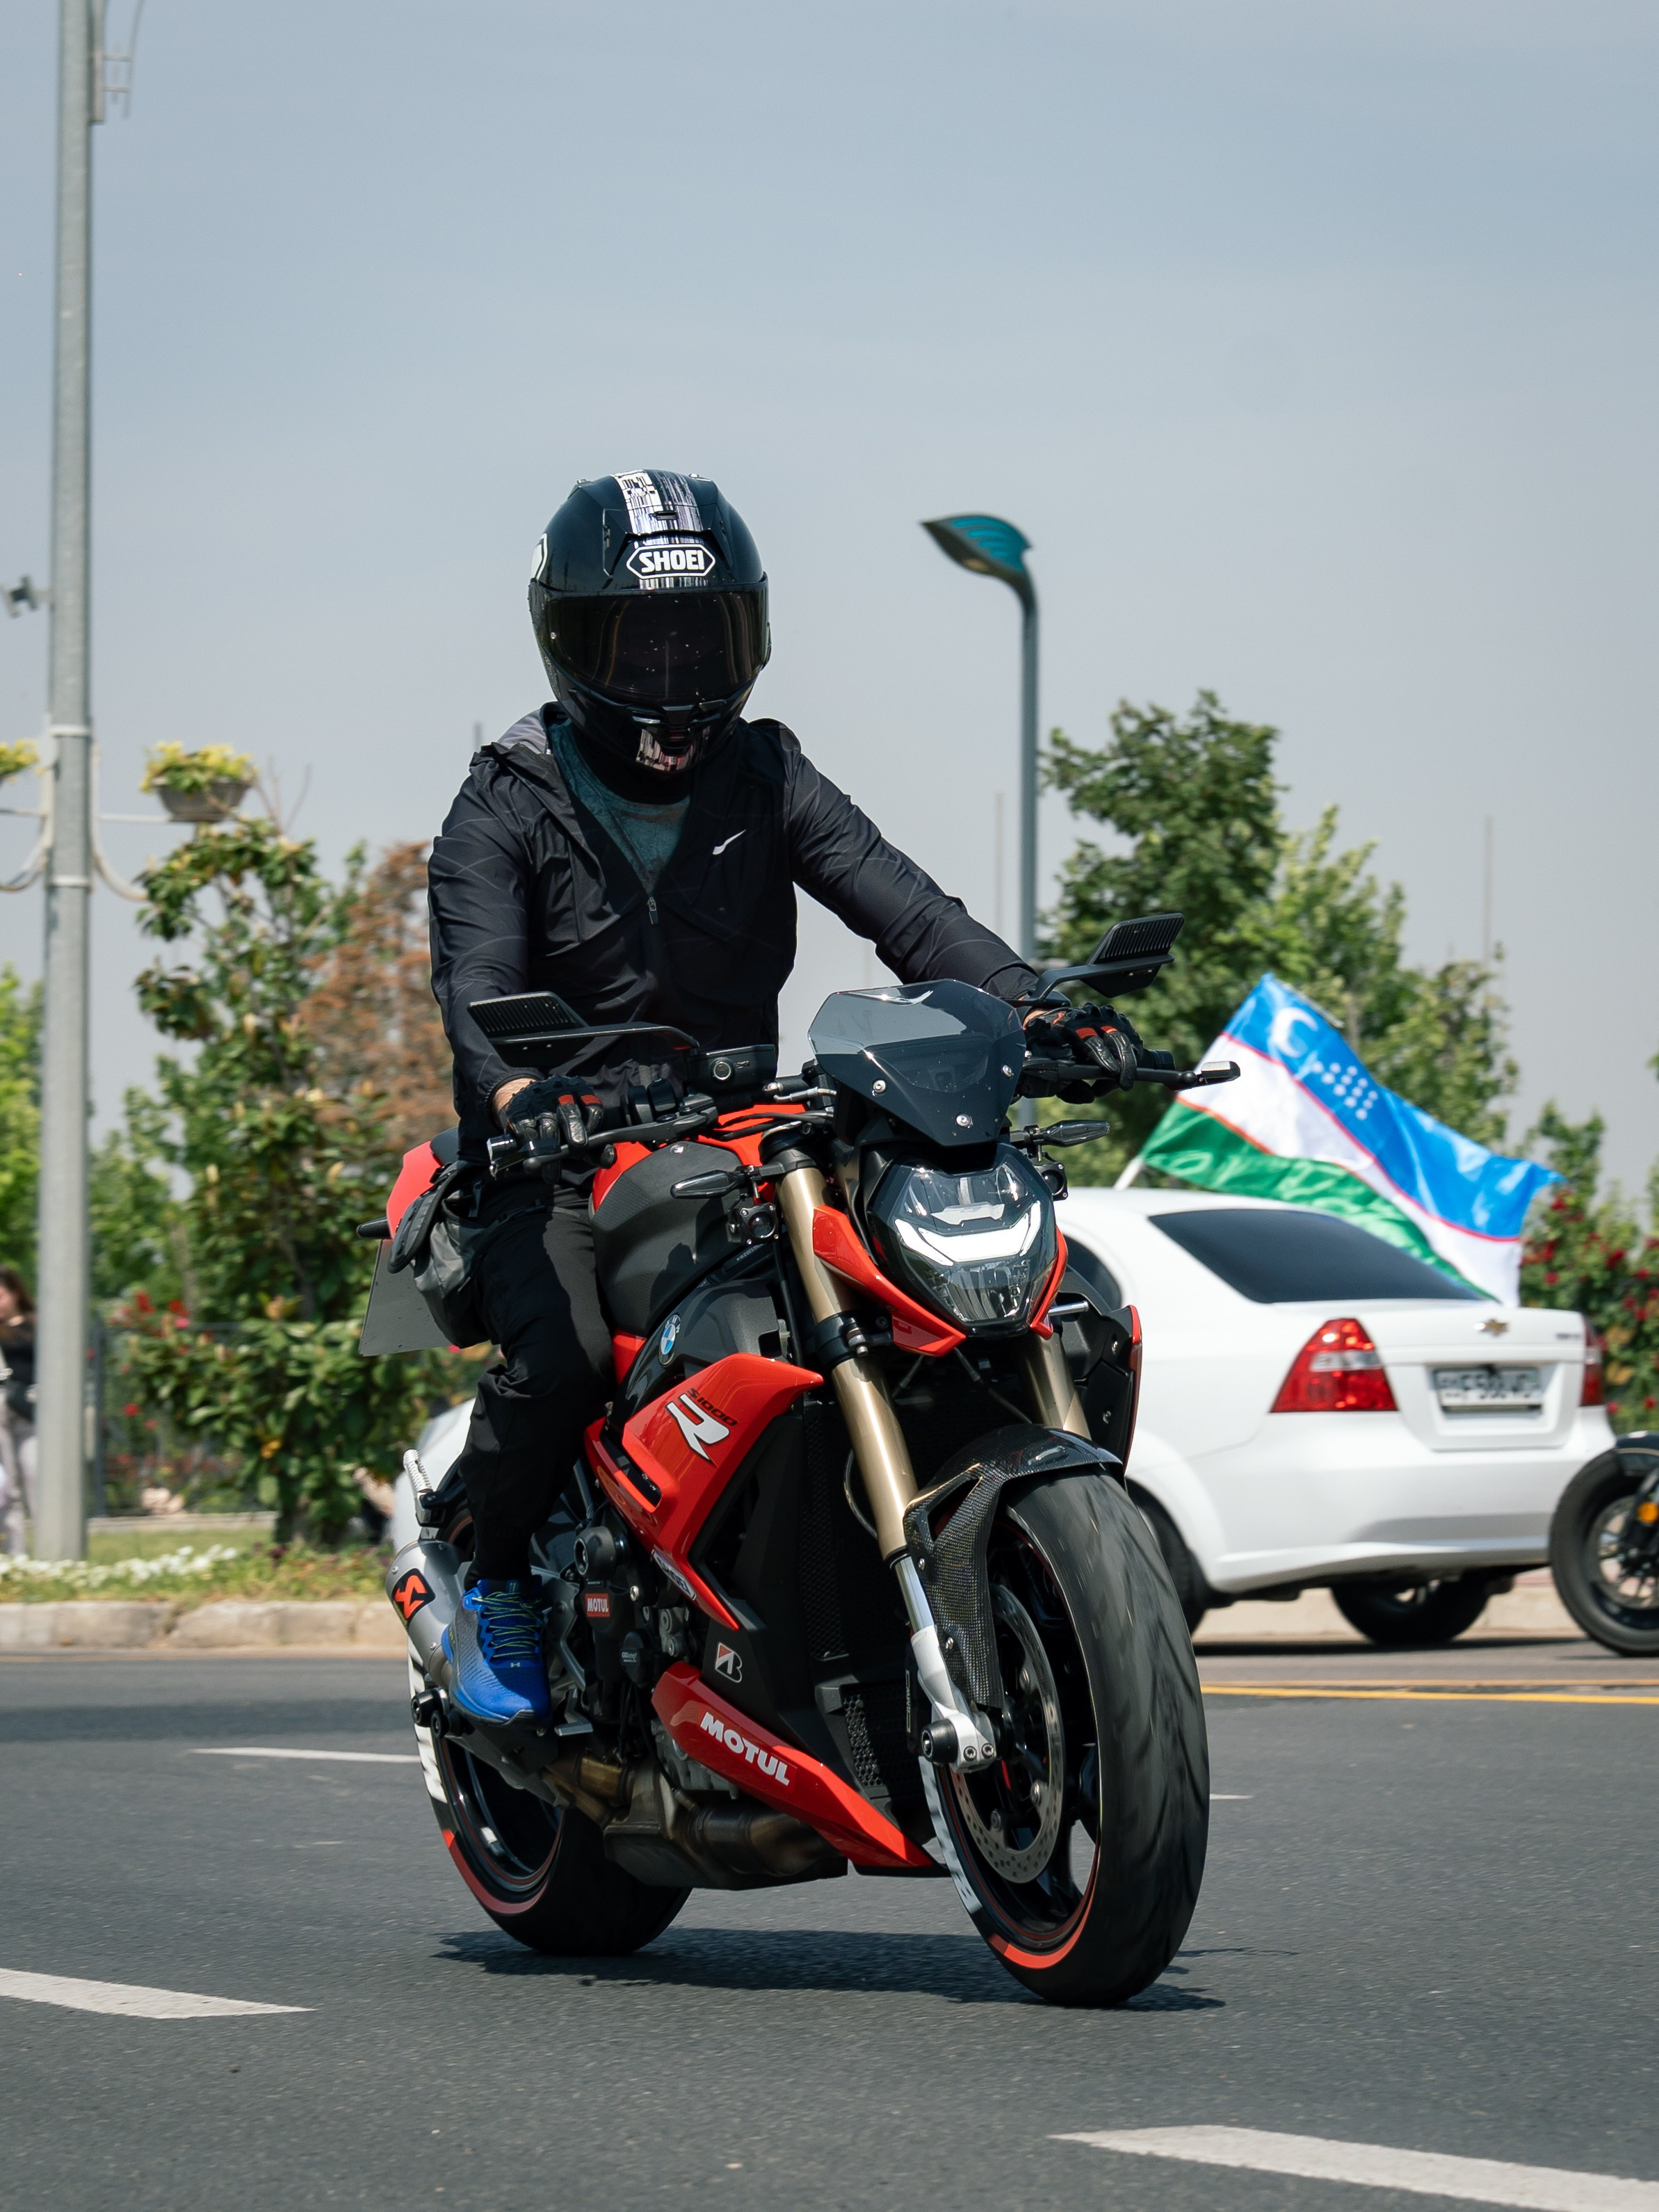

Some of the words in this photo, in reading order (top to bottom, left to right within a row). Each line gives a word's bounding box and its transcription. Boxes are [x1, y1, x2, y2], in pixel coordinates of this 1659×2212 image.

[638, 549, 705, 573] SHOEI
[587, 1597, 609, 1613] MOTUL
[700, 1711, 790, 1786] MOTUL
